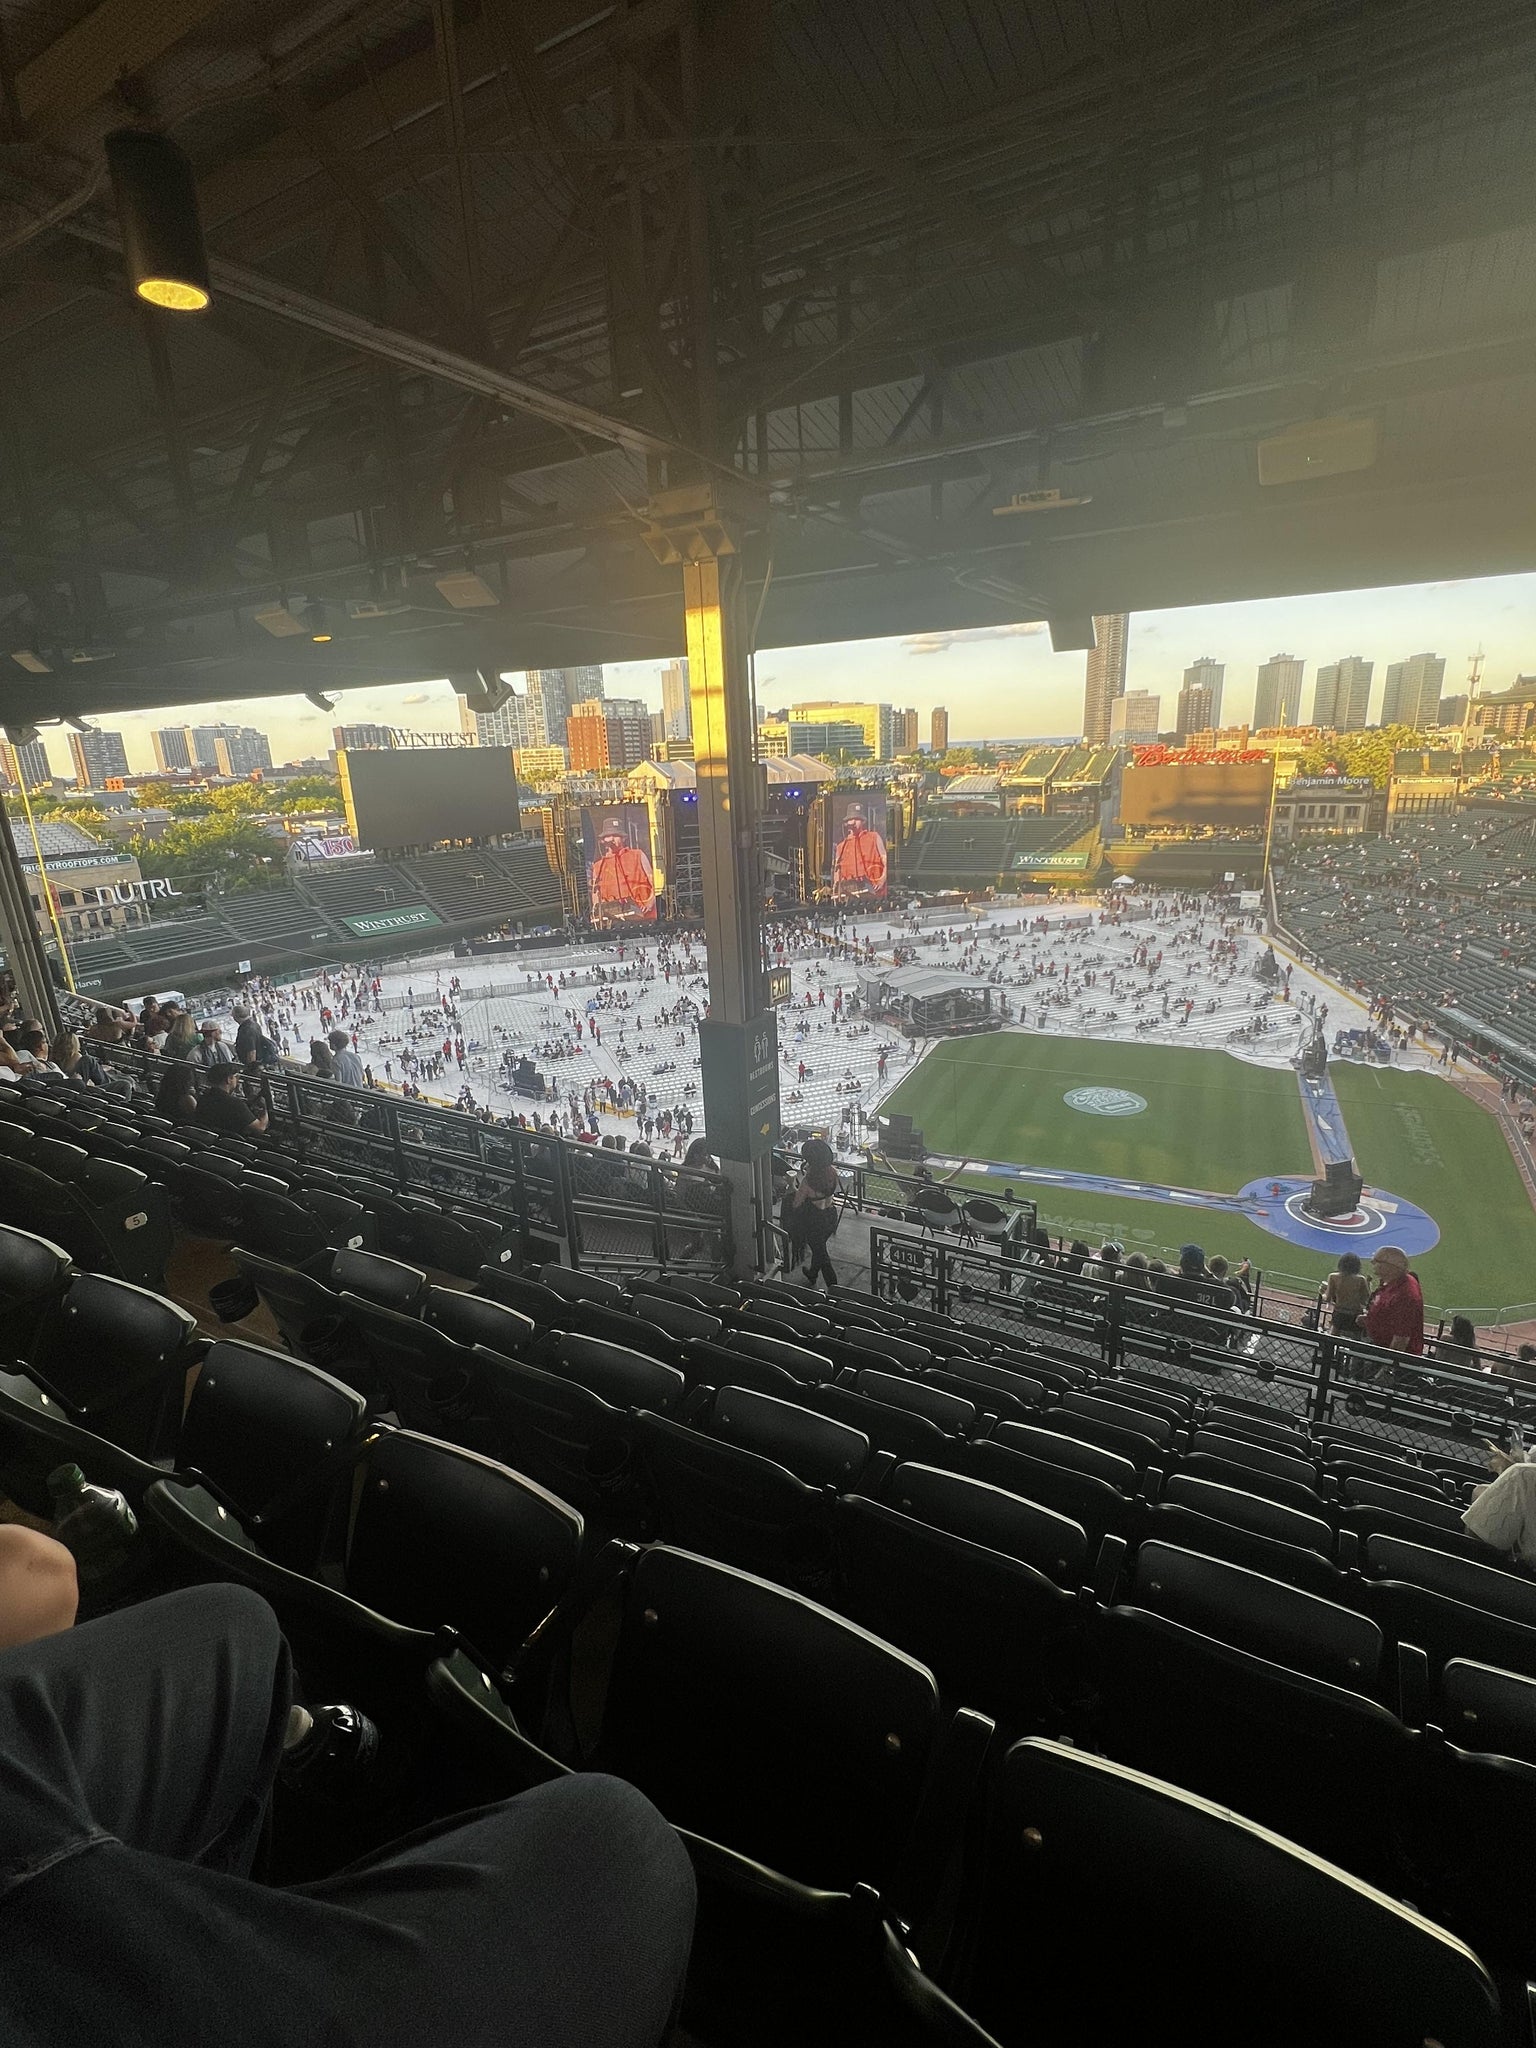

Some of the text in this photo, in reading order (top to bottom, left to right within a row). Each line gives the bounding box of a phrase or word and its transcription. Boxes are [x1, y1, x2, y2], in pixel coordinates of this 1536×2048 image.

[389, 728, 476, 748] WINTRUST
[1337, 776, 1369, 785] Moore
[321, 838, 356, 857] 150
[1017, 855, 1083, 865] WINTRUST
[353, 912, 430, 932] WINTRUST
[771, 976, 790, 998] EXIT
[132, 1216, 140, 1226] 5
[893, 1250, 918, 1265] 413L
